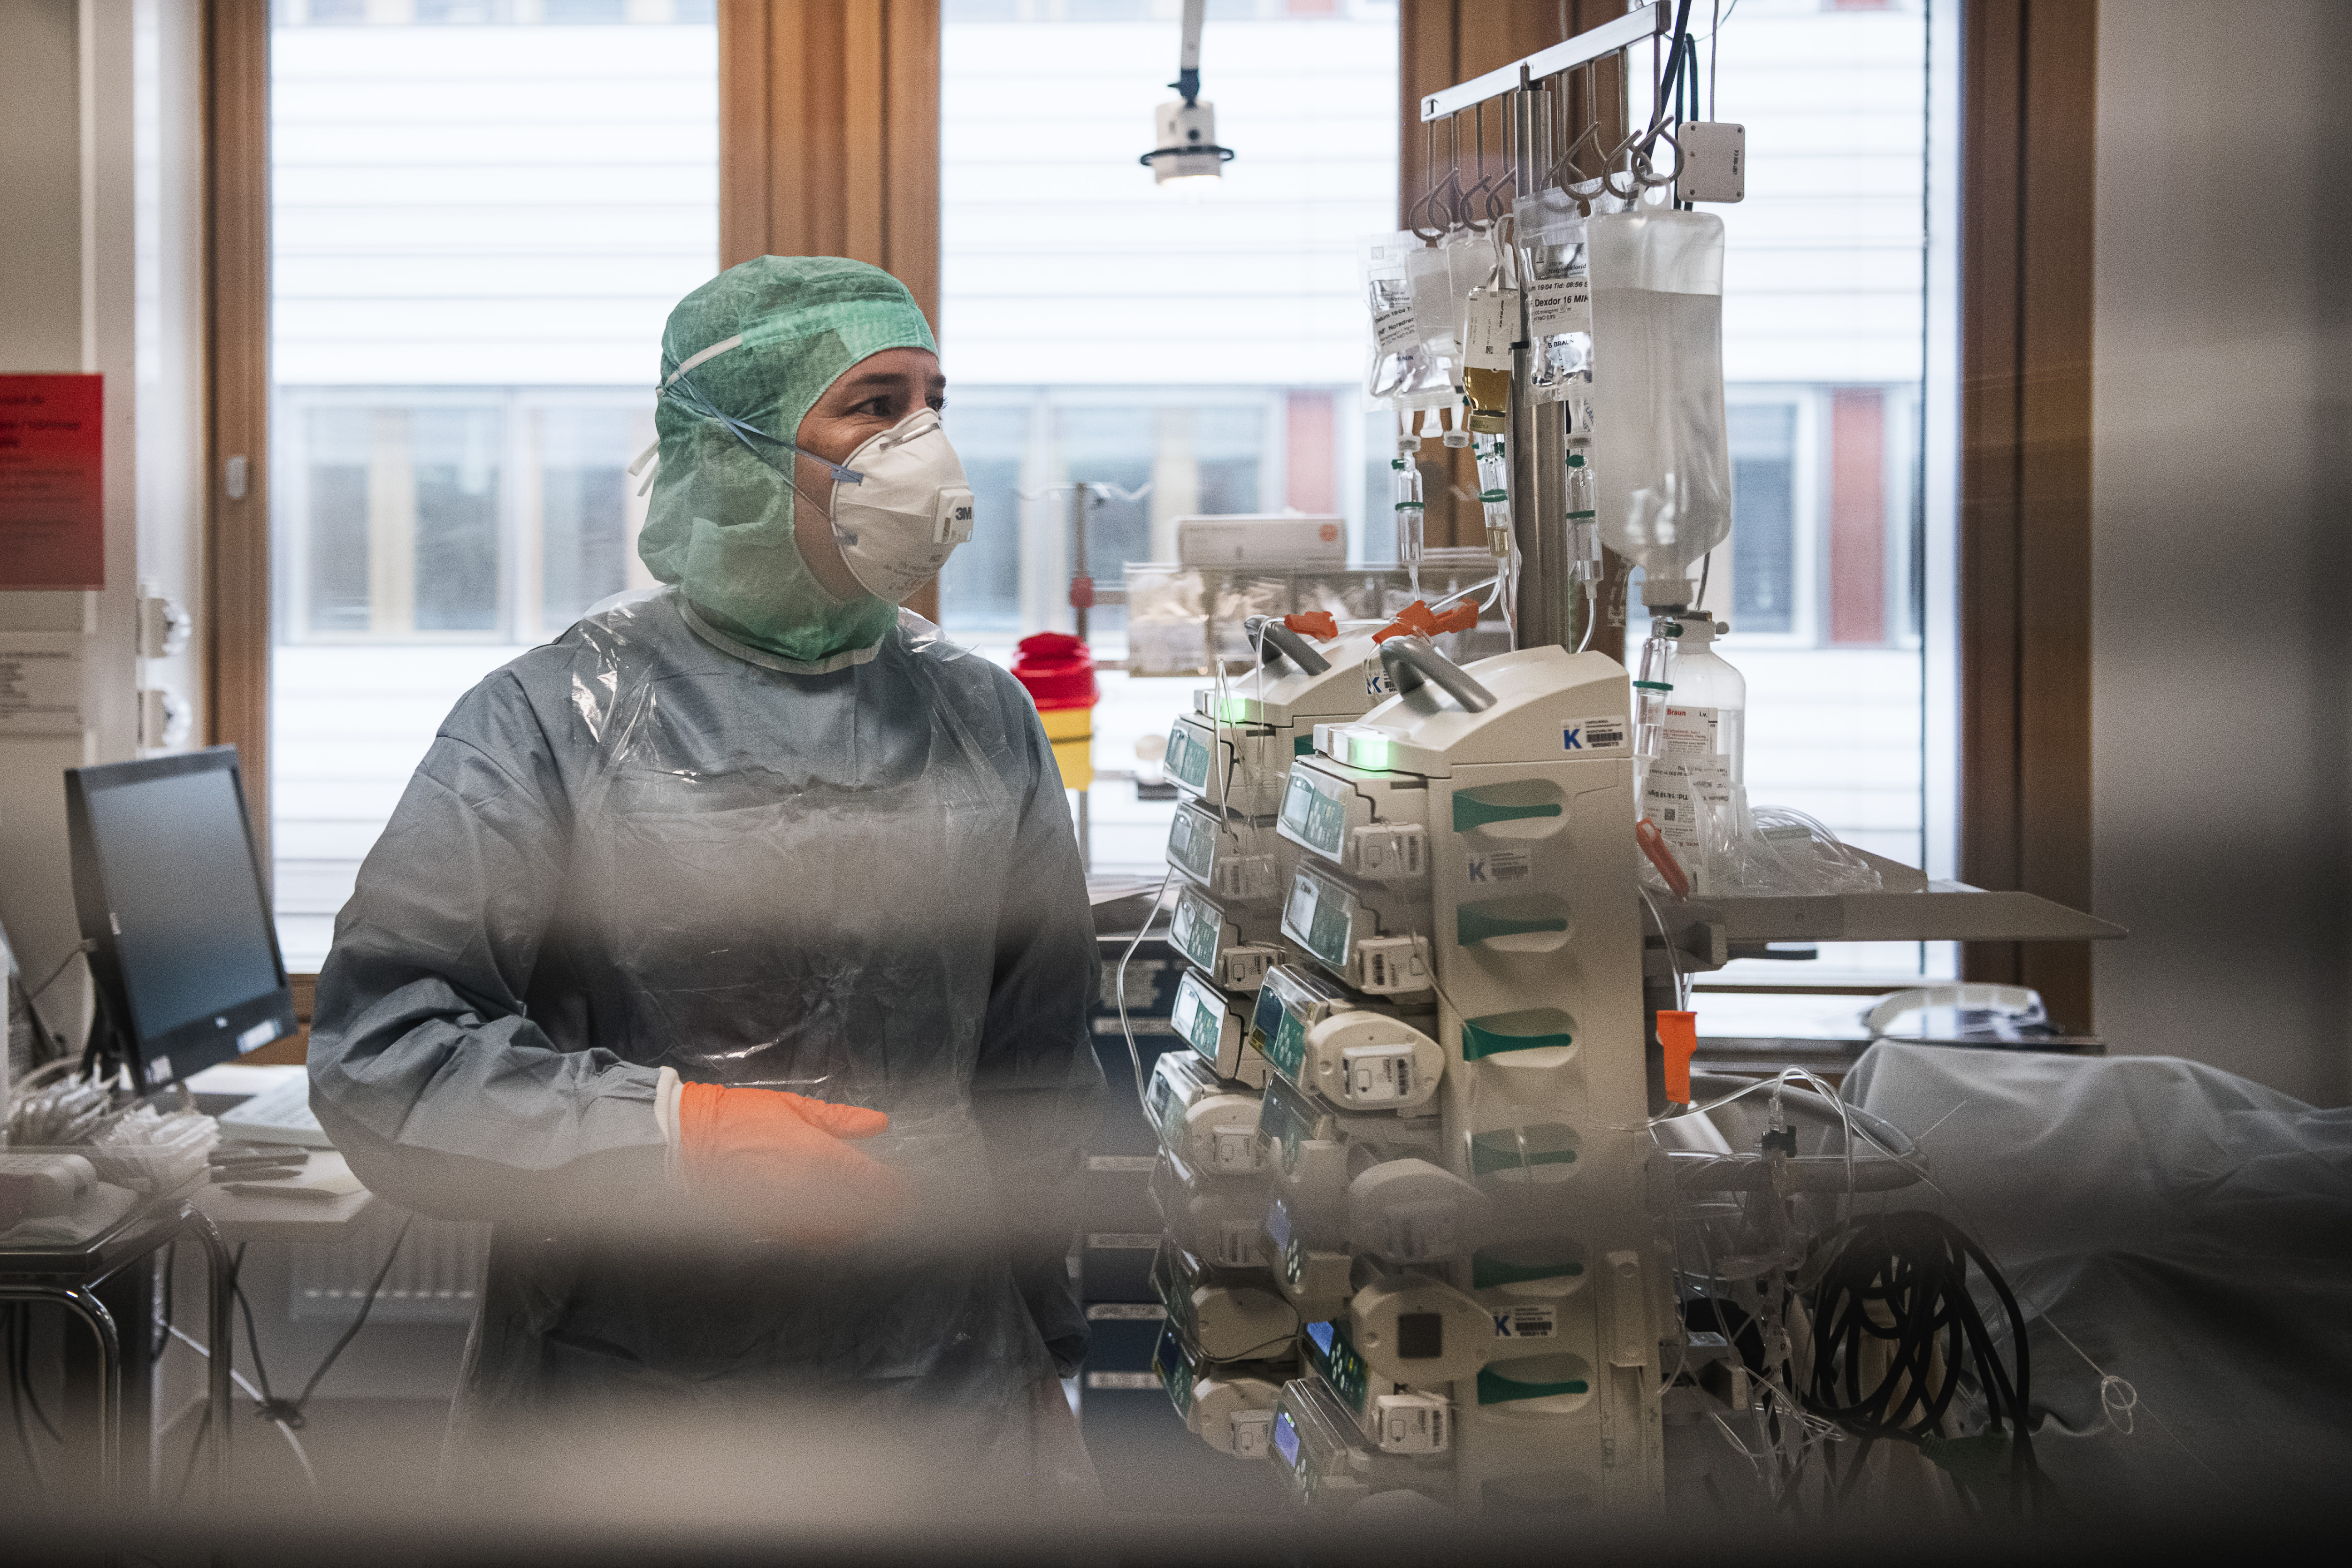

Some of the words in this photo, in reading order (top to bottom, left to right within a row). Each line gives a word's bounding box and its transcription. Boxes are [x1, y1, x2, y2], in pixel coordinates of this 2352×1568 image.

[1535, 298, 1561, 307] Dexdor
[1563, 296, 1572, 304] 16
[956, 507, 972, 520] 3M
[1563, 728, 1582, 750] K
[1470, 862, 1487, 883] K
[1494, 1316, 1511, 1336] K
